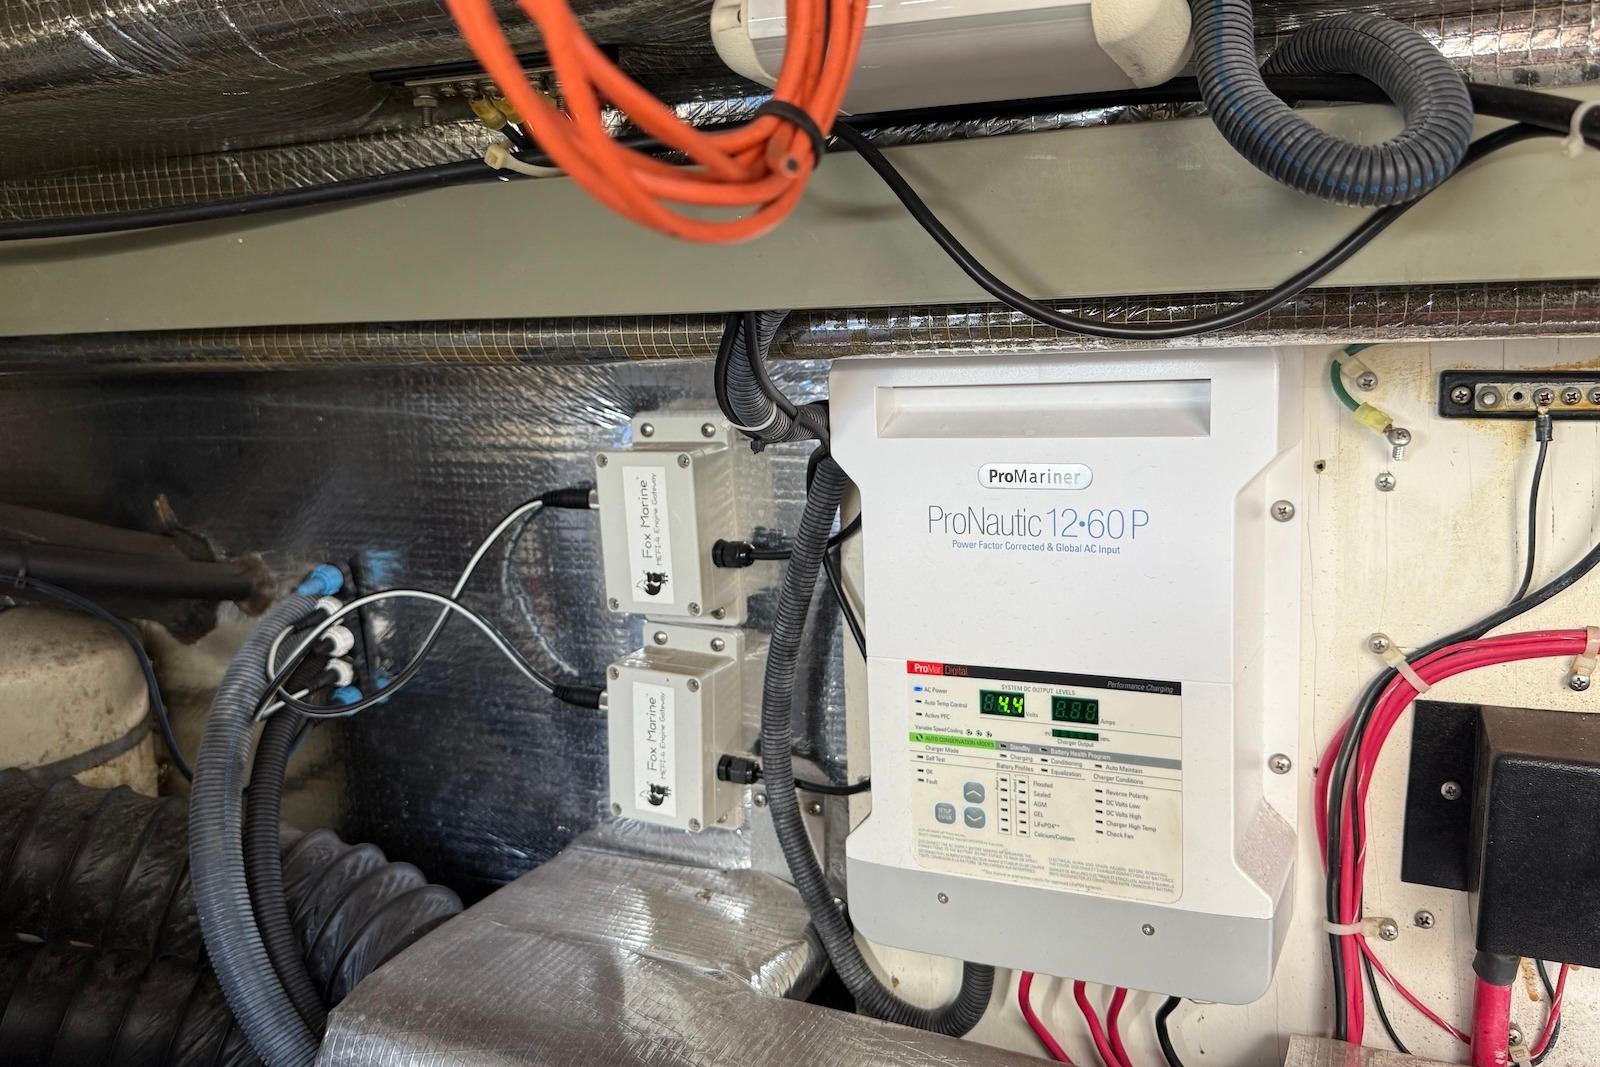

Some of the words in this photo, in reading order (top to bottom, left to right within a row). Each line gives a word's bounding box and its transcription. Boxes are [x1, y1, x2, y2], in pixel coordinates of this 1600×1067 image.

[989, 468, 1081, 485] ProMariner
[638, 480, 650, 528] Marine
[929, 505, 1042, 538] ProNautic
[1132, 509, 1150, 540] P
[642, 534, 653, 559] Fox
[952, 540, 977, 549] Power
[979, 541, 1003, 550] Factor
[1005, 542, 1045, 552] Corrected
[1047, 543, 1054, 552] &
[1056, 543, 1082, 553] Global
[1084, 544, 1097, 554] AC
[1099, 545, 1121, 555] Input
[945, 664, 968, 677] Digital
[1001, 684, 1023, 692] SYSTEM
[1106, 680, 1144, 690] Performance
[1146, 685, 1174, 694] Charging
[658, 692, 666, 722] Gateway
[935, 700, 949, 708] Temp
[646, 697, 657, 742] Marine
[925, 745, 944, 753] Charger
[1057, 739, 1077, 747] Charger
[647, 747, 657, 771] Fox
[1010, 753, 1033, 761] Charging
[1051, 748, 1071, 757] Battery
[1071, 750, 1087, 758] Health
[1088, 752, 1111, 760] Program
[997, 762, 1014, 771] Battery
[1014, 764, 1034, 772] Profiles
[1051, 758, 1082, 768] Conditioning
[1051, 769, 1082, 777] Equalization
[1119, 766, 1143, 774] Maintain
[1093, 774, 1115, 782] Charger
[1116, 776, 1143, 785] Conditions
[1034, 791, 1051, 799] Sealed
[1106, 789, 1127, 797] Reverse
[1128, 792, 1149, 801] Polarity
[1129, 813, 1142, 821] High
[1106, 820, 1127, 829] Charger
[1128, 823, 1141, 831] High
[1142, 824, 1157, 833] Temp
